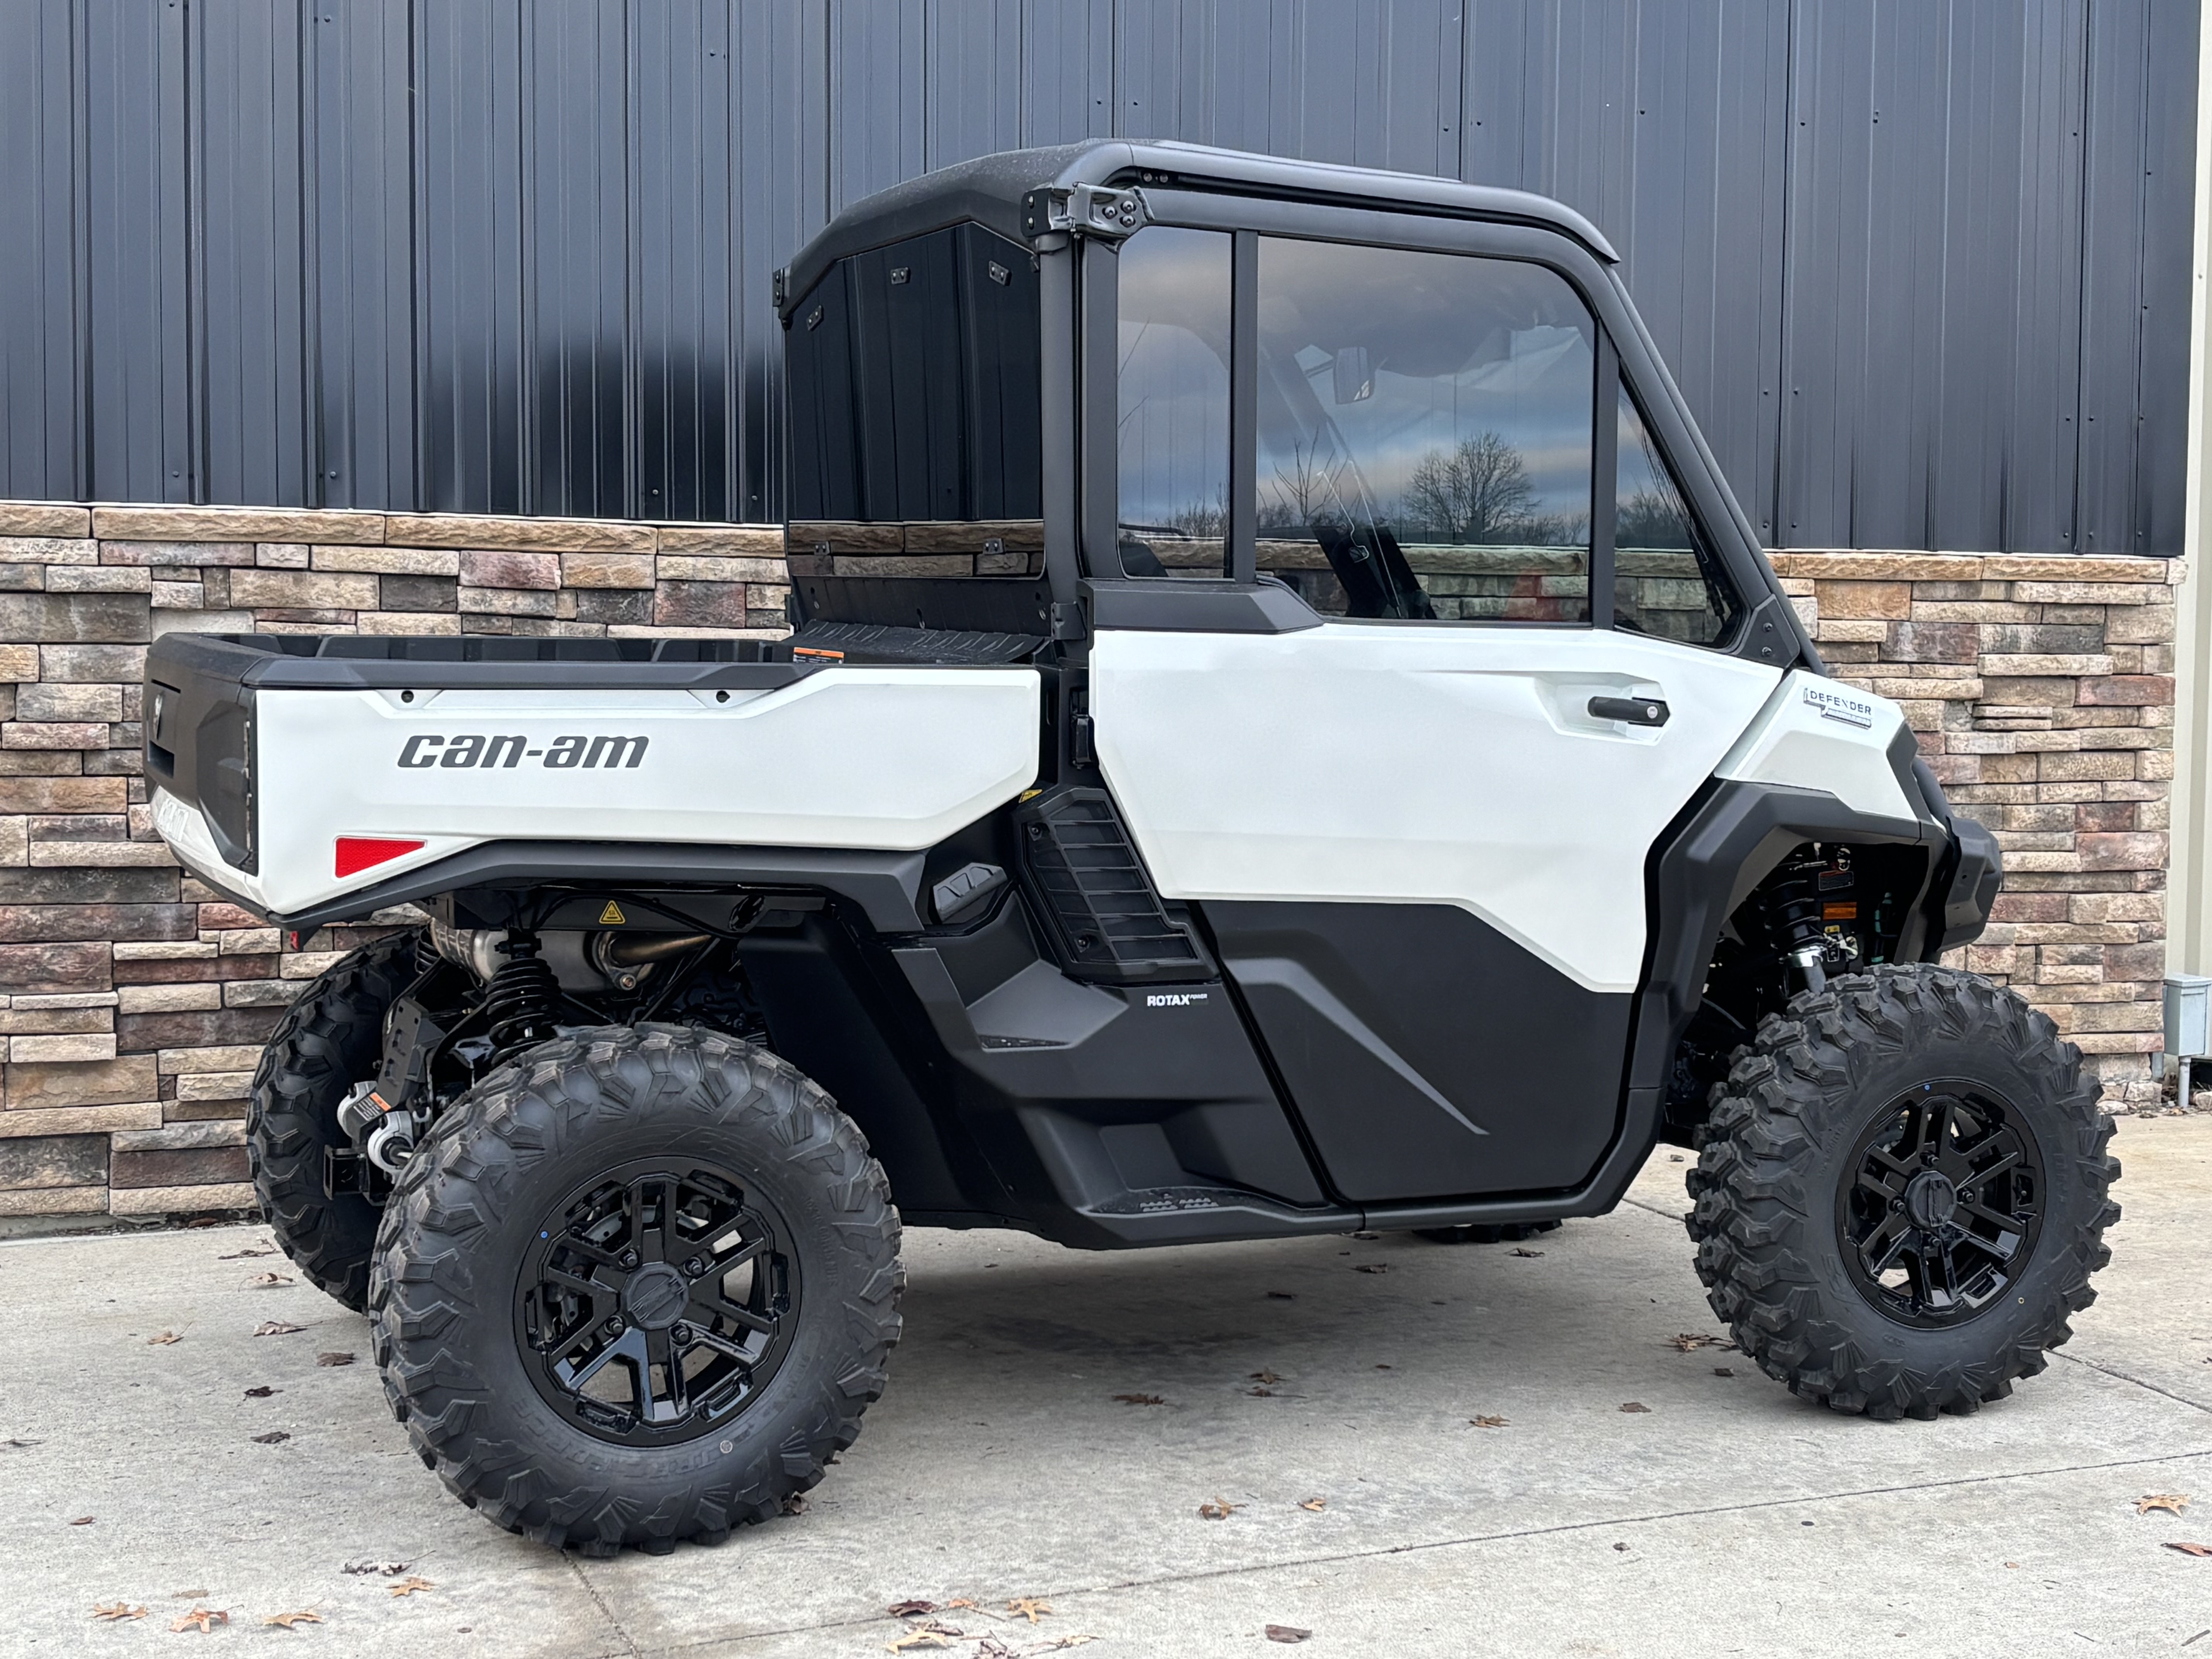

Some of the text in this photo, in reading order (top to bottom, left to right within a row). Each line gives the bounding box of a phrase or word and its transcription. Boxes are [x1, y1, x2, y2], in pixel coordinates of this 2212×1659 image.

[1810, 690, 1871, 715] DEFENDER
[397, 735, 649, 768] can-am
[1147, 994, 1190, 1006] ROTAX
